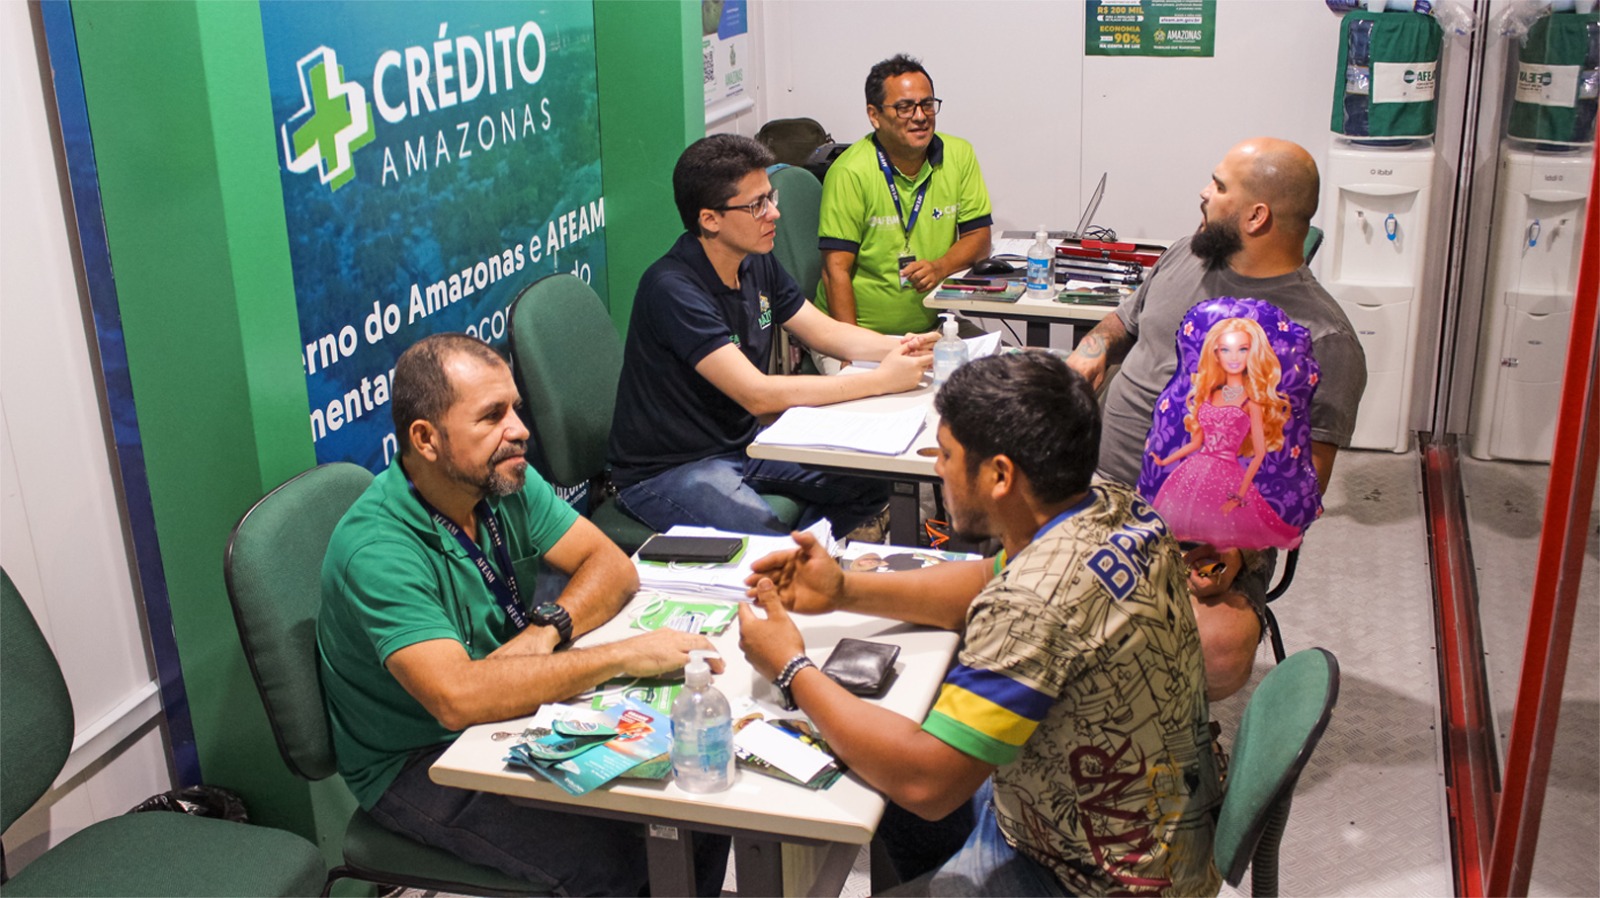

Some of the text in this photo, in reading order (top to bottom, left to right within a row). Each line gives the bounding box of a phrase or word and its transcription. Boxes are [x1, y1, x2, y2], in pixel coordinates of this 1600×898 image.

[1114, 33, 1141, 44] 90%
[1167, 30, 1202, 40] AMAZONAS
[372, 20, 547, 123] CRÉDITO
[382, 98, 552, 187] AMAZONAS
[365, 301, 401, 345] do
[408, 244, 526, 325] Amazonas
[530, 233, 542, 263] e
[546, 197, 606, 257] AFEAM
[433, 514, 459, 536] AFEAM
[476, 557, 496, 583] AFEAM
[506, 605, 525, 629] AFEAM
